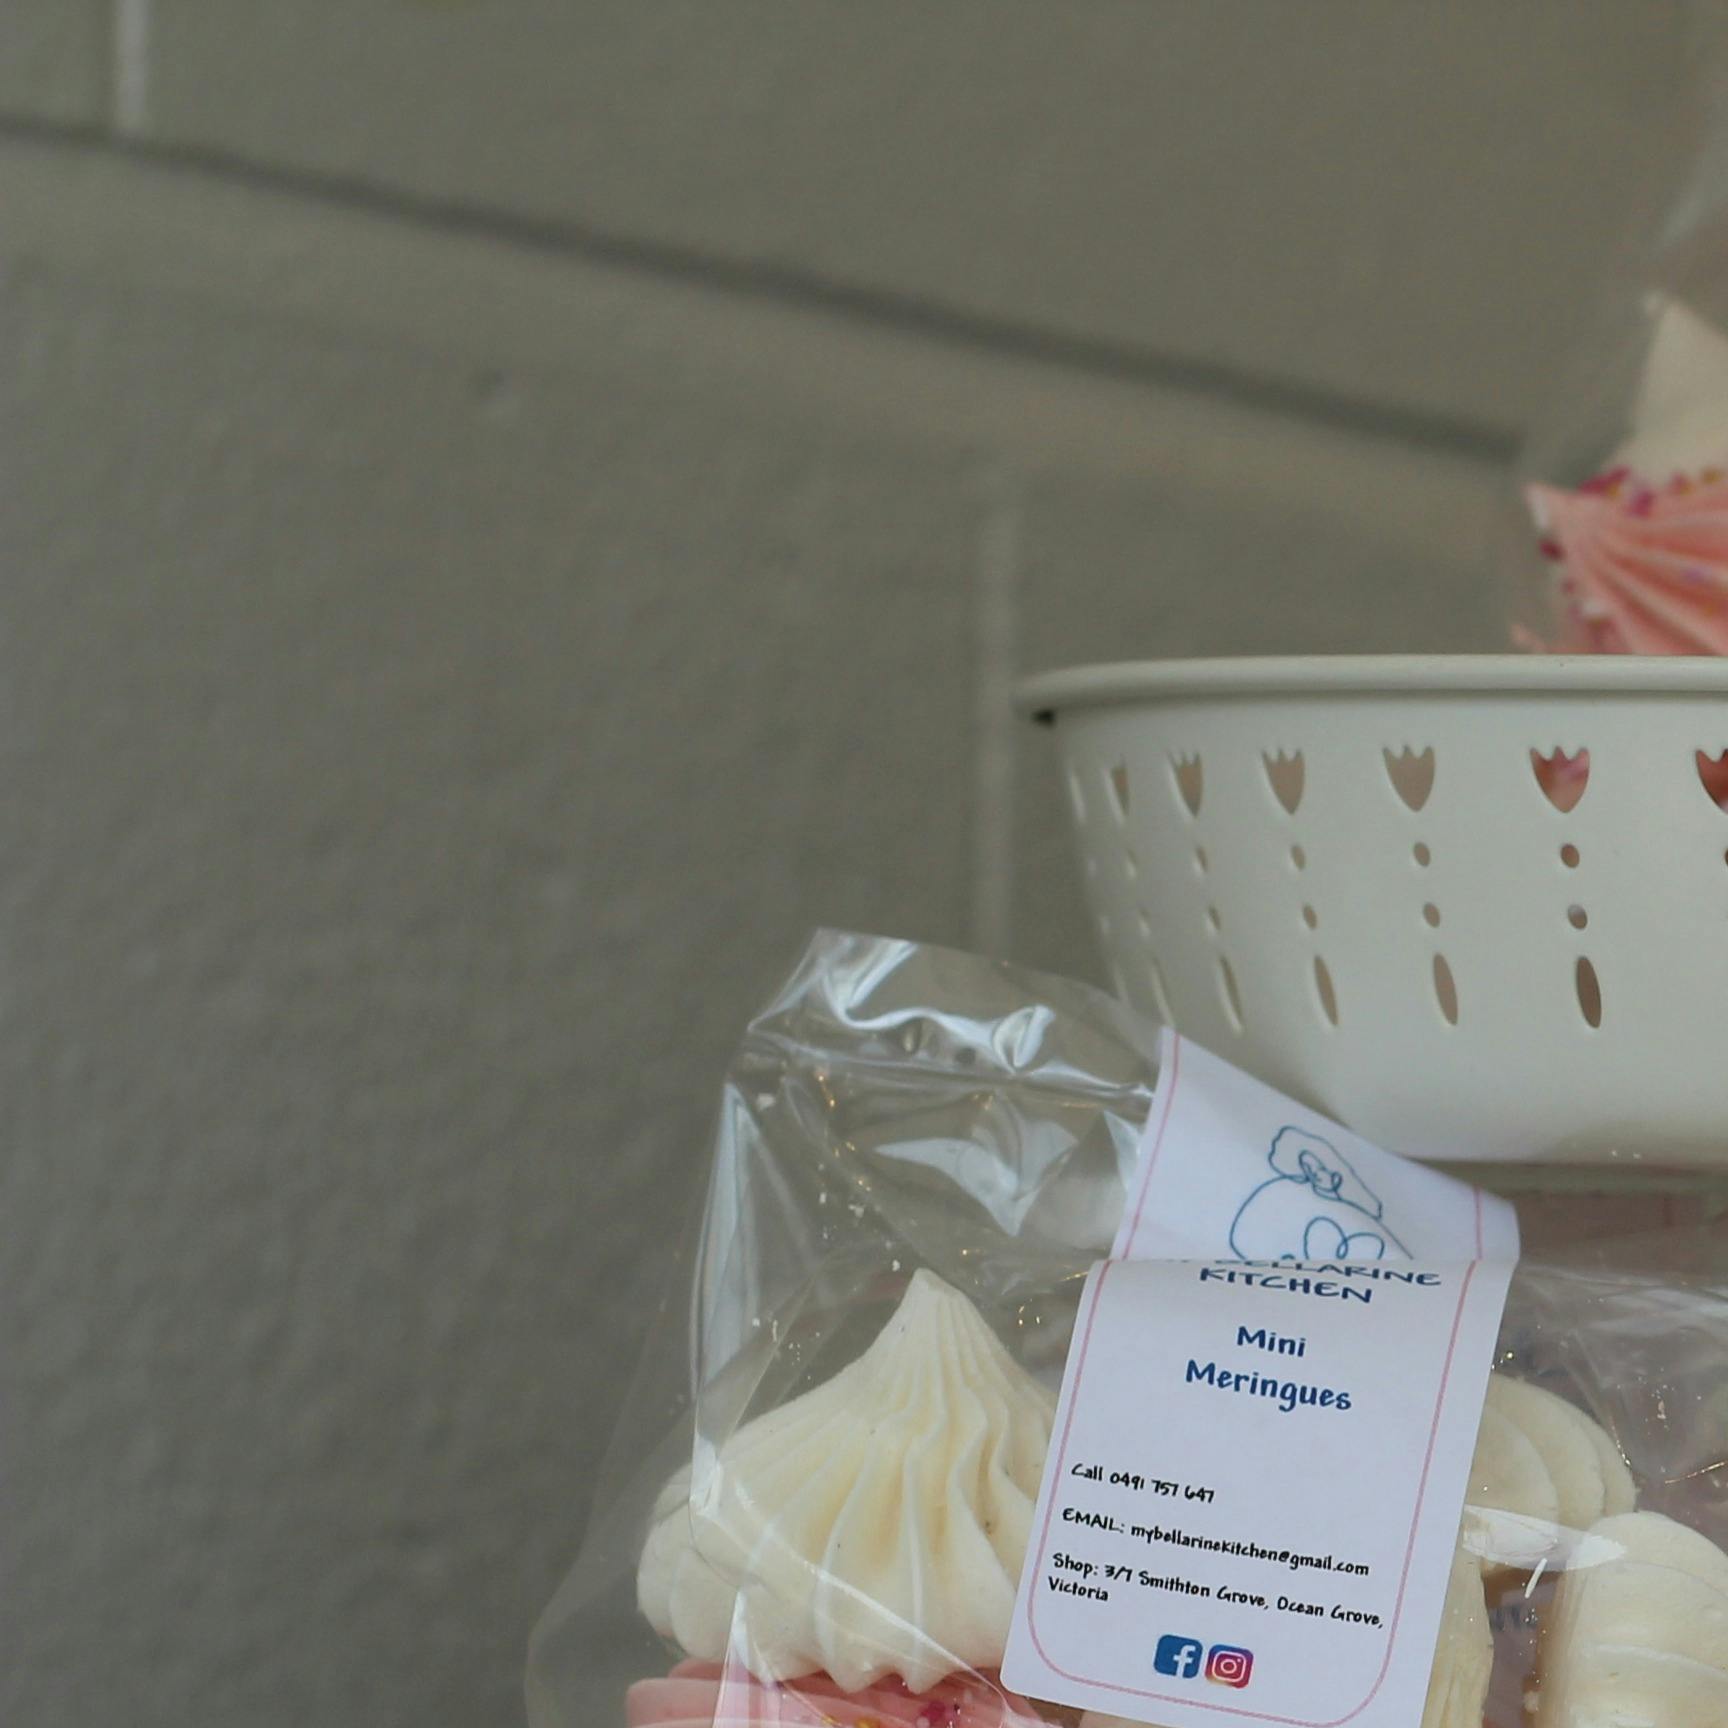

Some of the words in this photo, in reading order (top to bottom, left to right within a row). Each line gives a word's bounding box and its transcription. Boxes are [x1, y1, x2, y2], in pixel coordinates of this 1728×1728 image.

[1200, 1268, 1372, 1303] KITCHEN
[1215, 1258, 1441, 1287] ELLARINE
[1236, 1326, 1306, 1357] Mini
[1185, 1359, 1351, 1412] Meringues
[1071, 1463, 1102, 1481] Call
[1109, 1472, 1145, 1491] 0491
[1151, 1479, 1179, 1497] 757
[1184, 1485, 1215, 1503] 647
[1062, 1507, 1125, 1533] EMAIL:
[1131, 1524, 1369, 1576] mybellarinekitchen@gmail.com
[1048, 1575, 1109, 1602] Victoria
[1052, 1553, 1098, 1579] Shop:
[1138, 1570, 1210, 1598] Smithton
[1216, 1585, 1269, 1610] Grove,
[1277, 1597, 1324, 1617] Ocean
[1330, 1604, 1384, 1629] Grove,
